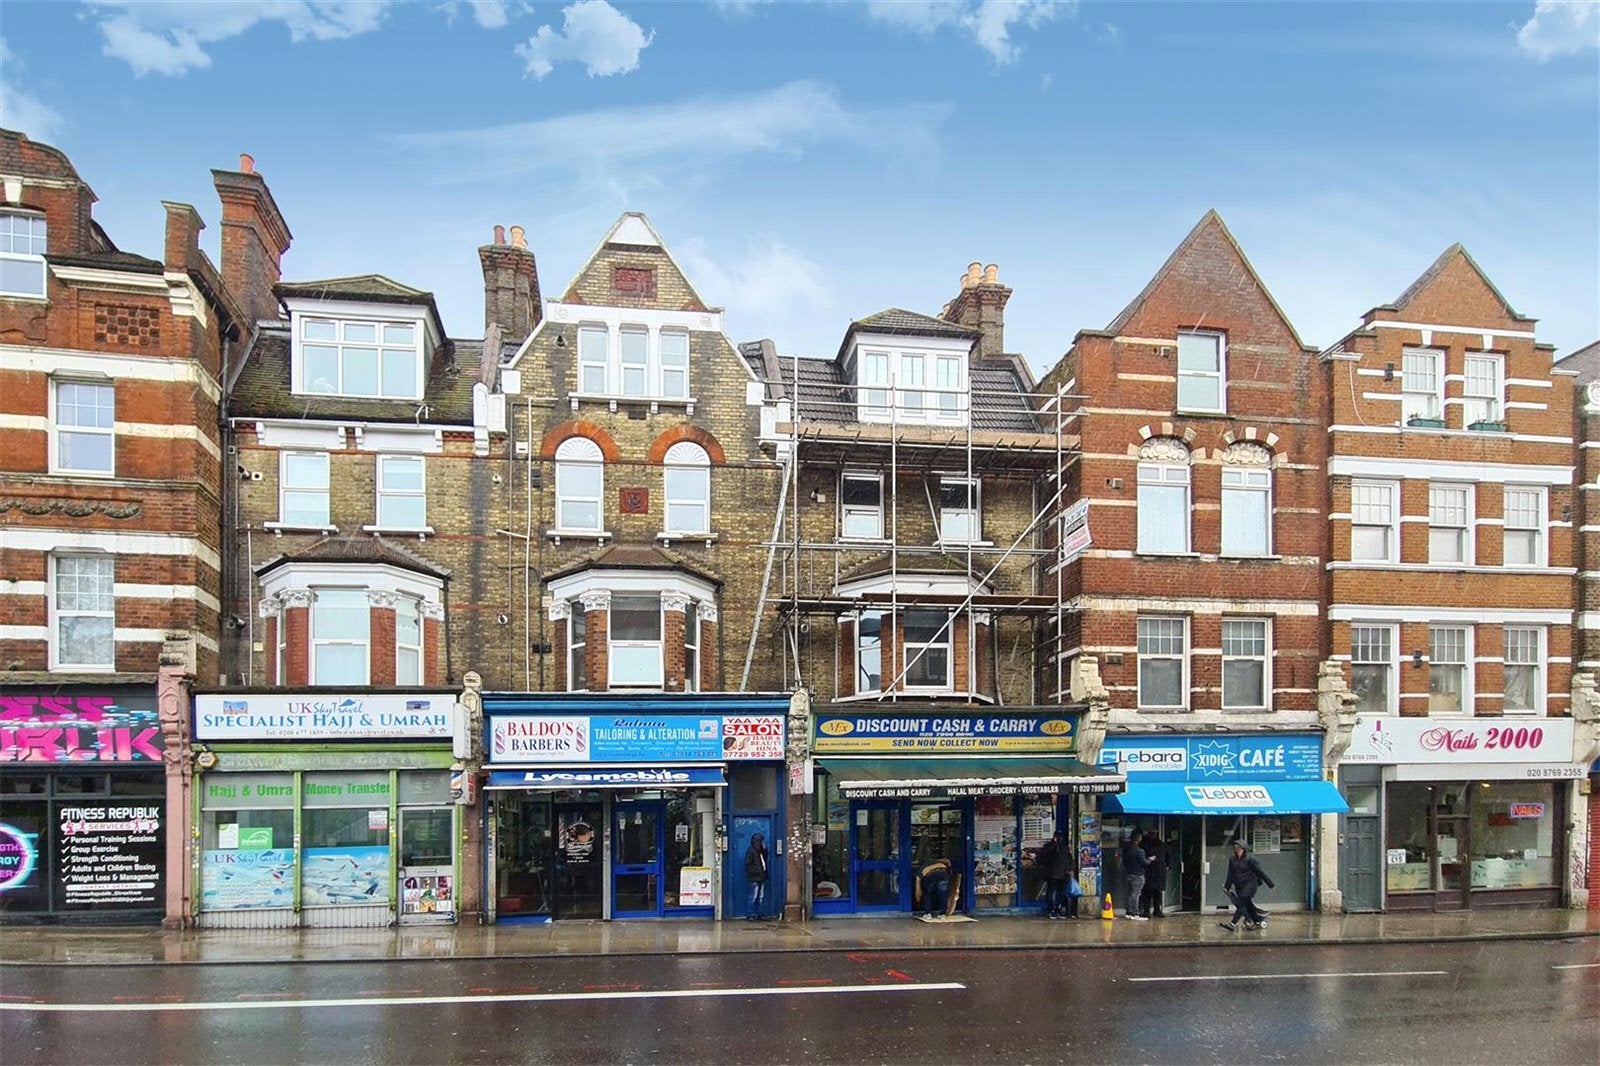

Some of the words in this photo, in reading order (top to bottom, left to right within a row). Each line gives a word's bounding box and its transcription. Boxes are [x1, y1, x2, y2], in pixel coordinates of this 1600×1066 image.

[288, 702, 312, 714] UK
[203, 714, 307, 728] SPECIALIST
[313, 714, 353, 728] HAJJ
[360, 713, 374, 727] &
[380, 713, 446, 727] UMRAH
[856, 718, 929, 733] DISCOUNT
[931, 718, 970, 733] CASH
[974, 718, 985, 733] &
[989, 718, 1038, 733] CARRY
[507, 721, 574, 737] BALDO'S
[594, 728, 638, 741] TAILORING
[640, 728, 646, 740] &
[648, 727, 696, 740] ALTERATION
[723, 724, 782, 736] SALON
[511, 738, 571, 751] BARBERS
[892, 739, 915, 747] SEND
[917, 739, 938, 747] NOW
[940, 739, 976, 747] COLLECT
[978, 738, 1000, 747] NOW
[1420, 727, 1479, 753] Nails
[1484, 727, 1543, 749] 2000
[1119, 750, 1183, 763] Lebara
[1198, 754, 1229, 767] XIDIG
[1239, 744, 1285, 767] CAFÉ
[523, 768, 690, 782] Lycamobile
[1526, 769, 1541, 777] 020
[1543, 769, 1561, 777] 8769
[1563, 768, 1582, 776] 2355
[209, 785, 237, 798] Hajj
[242, 785, 251, 796] &
[305, 783, 343, 795] Money
[845, 789, 877, 798] DISCOUNT
[878, 789, 896, 797] CASH
[896, 788, 909, 797] AND
[910, 788, 932, 797] CARRY
[947, 787, 967, 796] HALAL
[967, 787, 984, 795] MEAT
[989, 786, 1017, 795] GROCERY
[1021, 785, 1059, 794] VEGETABLES
[1080, 784, 1090, 792] 020
[1203, 788, 1267, 800] Lebara
[60, 808, 105, 820] FITNESS
[108, 807, 159, 819] REPUBLIK
[100, 836, 127, 844] Training
[70, 846, 91, 854] Group
[70, 855, 99, 863] Strength
[100, 854, 139, 862] Conditioning
[214, 855, 236, 864] UK
[134, 864, 156, 872] Boxing
[71, 875, 94, 883] Weight
[119, 873, 159, 881] Management
